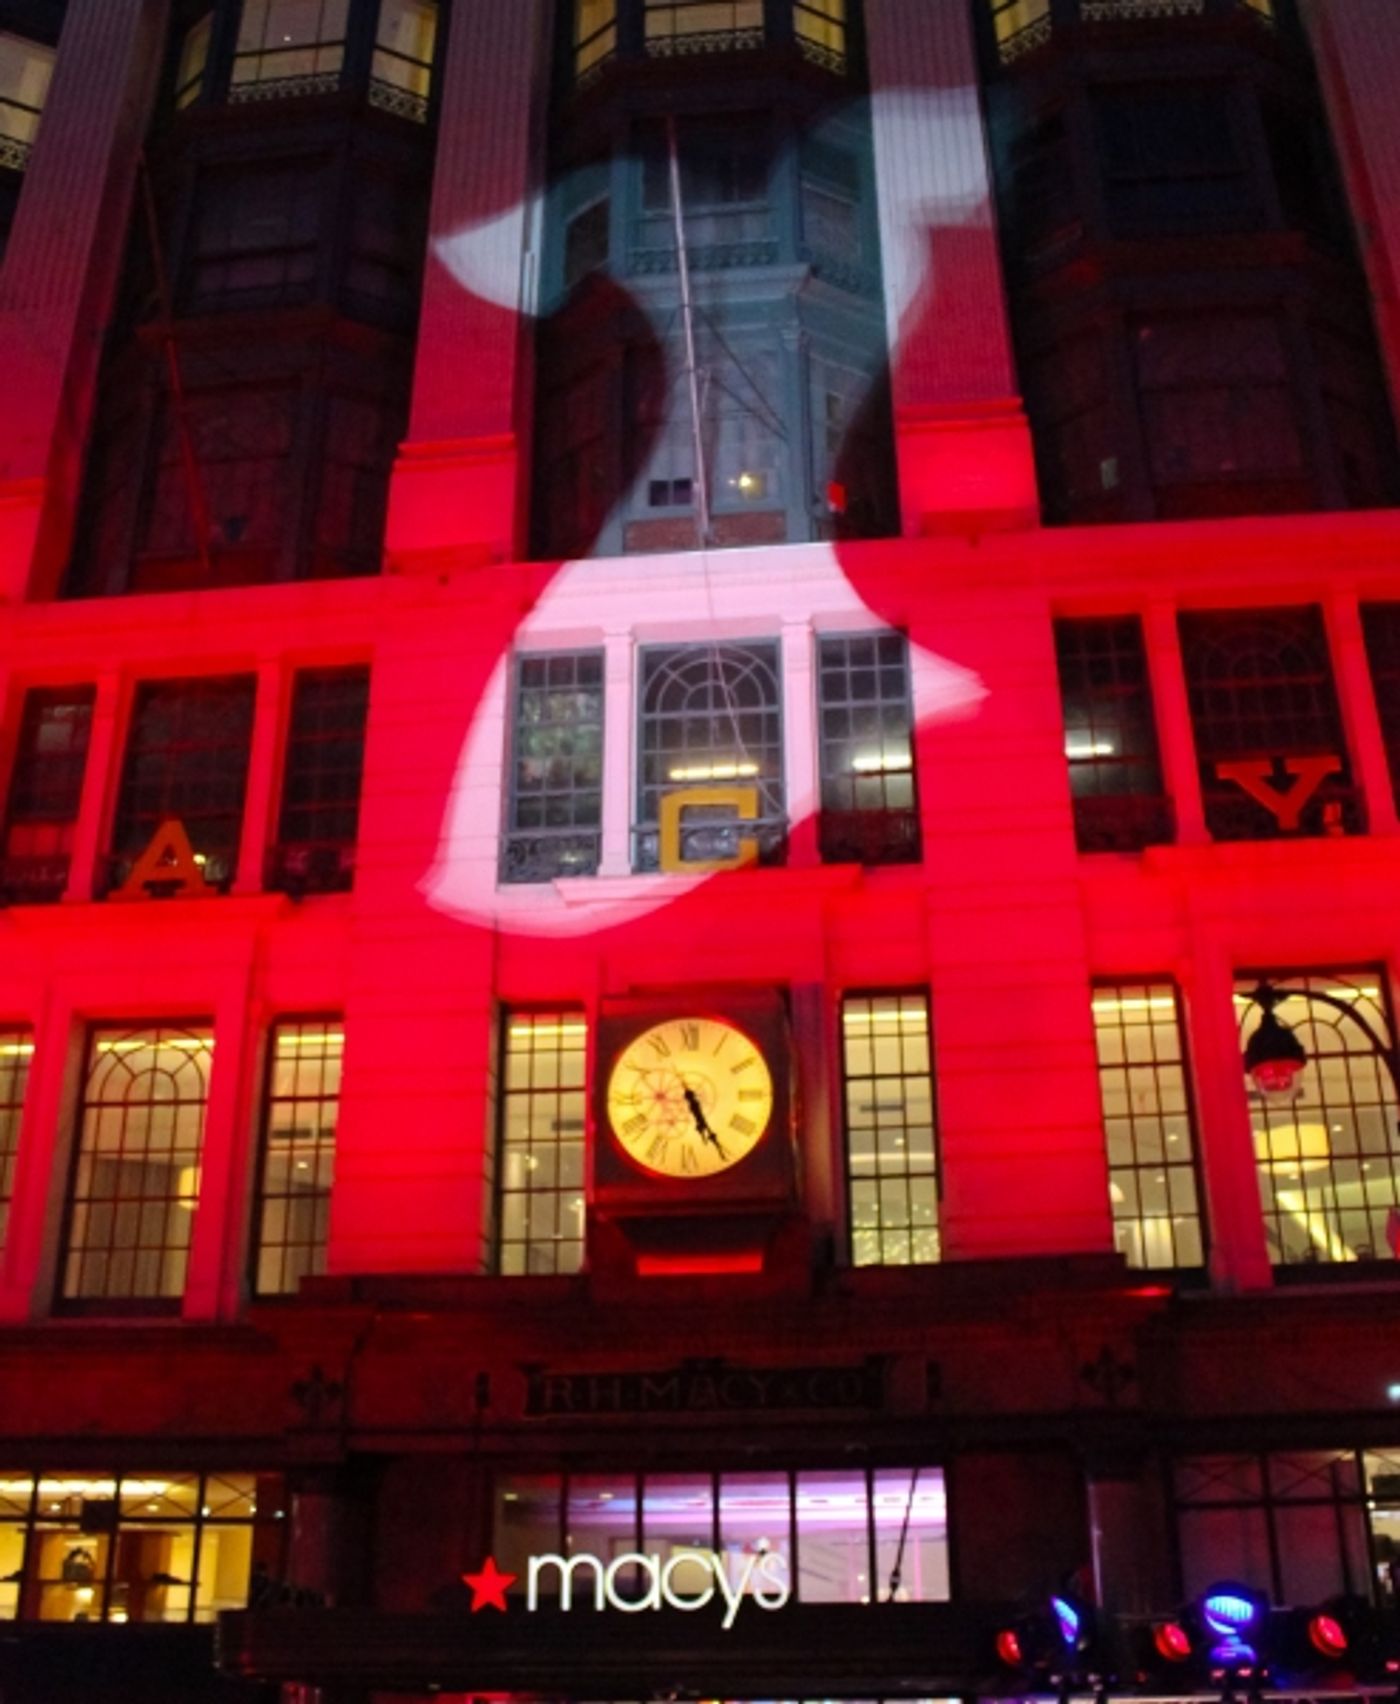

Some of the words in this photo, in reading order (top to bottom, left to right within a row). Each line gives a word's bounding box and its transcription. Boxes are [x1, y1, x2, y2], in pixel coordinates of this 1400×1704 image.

[107, 819, 220, 899] A
[659, 786, 759, 874] C
[1214, 754, 1342, 831] Y
